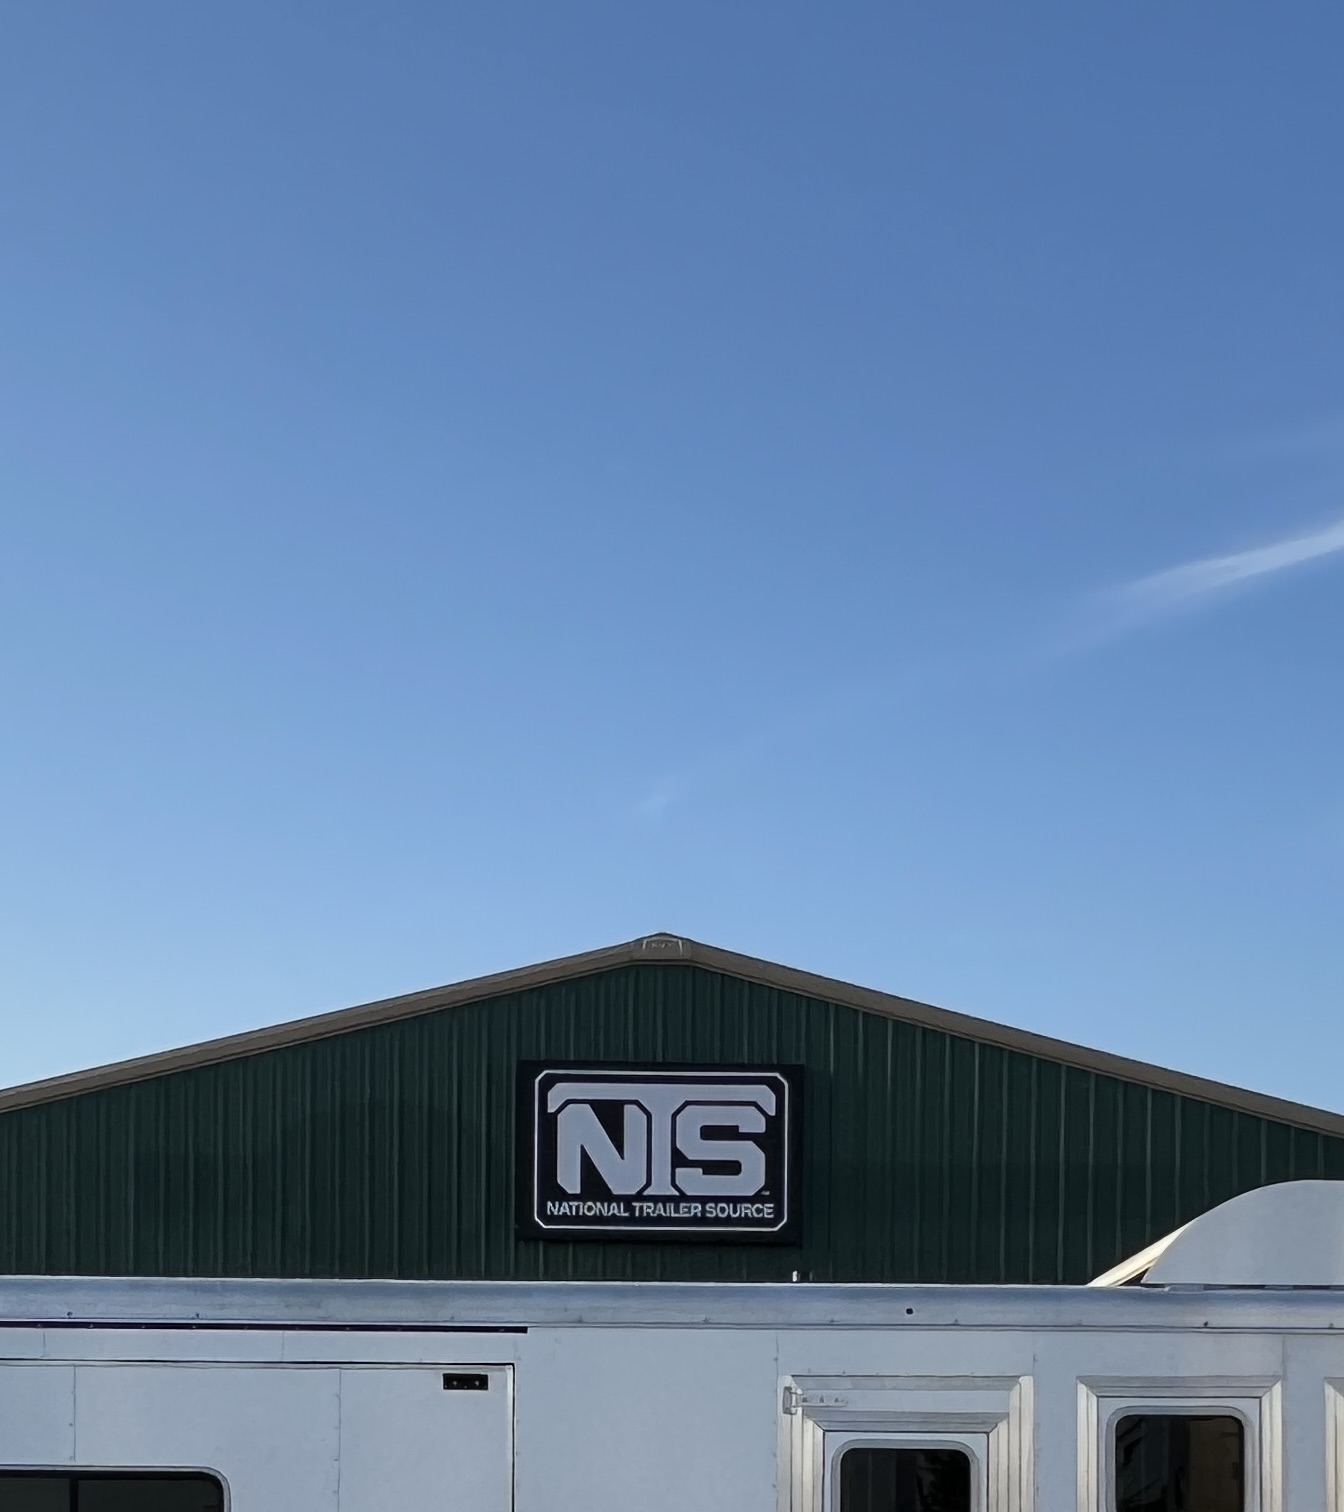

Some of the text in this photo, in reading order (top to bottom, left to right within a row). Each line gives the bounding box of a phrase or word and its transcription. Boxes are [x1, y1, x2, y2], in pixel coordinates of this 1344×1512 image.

[547, 1082, 776, 1197] NTS
[546, 1201, 775, 1218] NATIONAL TRAILER SOURCE
